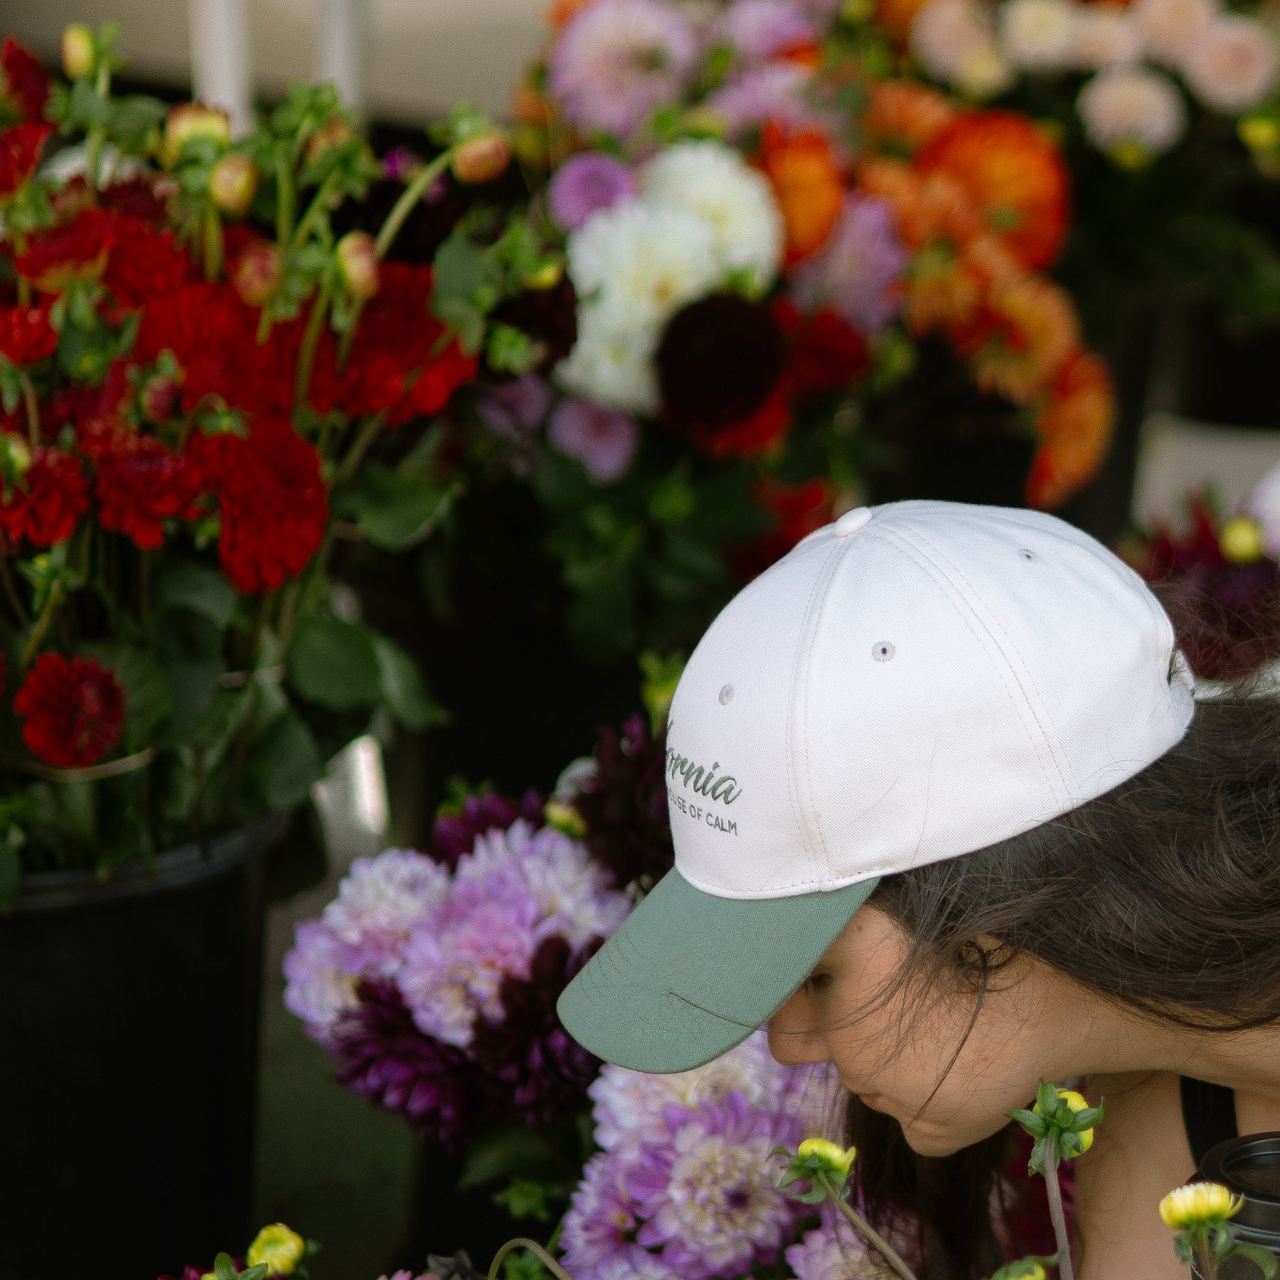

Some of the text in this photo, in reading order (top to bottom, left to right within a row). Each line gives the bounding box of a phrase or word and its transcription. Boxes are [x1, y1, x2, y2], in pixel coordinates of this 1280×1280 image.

[667, 747, 742, 804] ornia
[690, 806, 702, 820] OF
[706, 813, 737, 836] CALM
